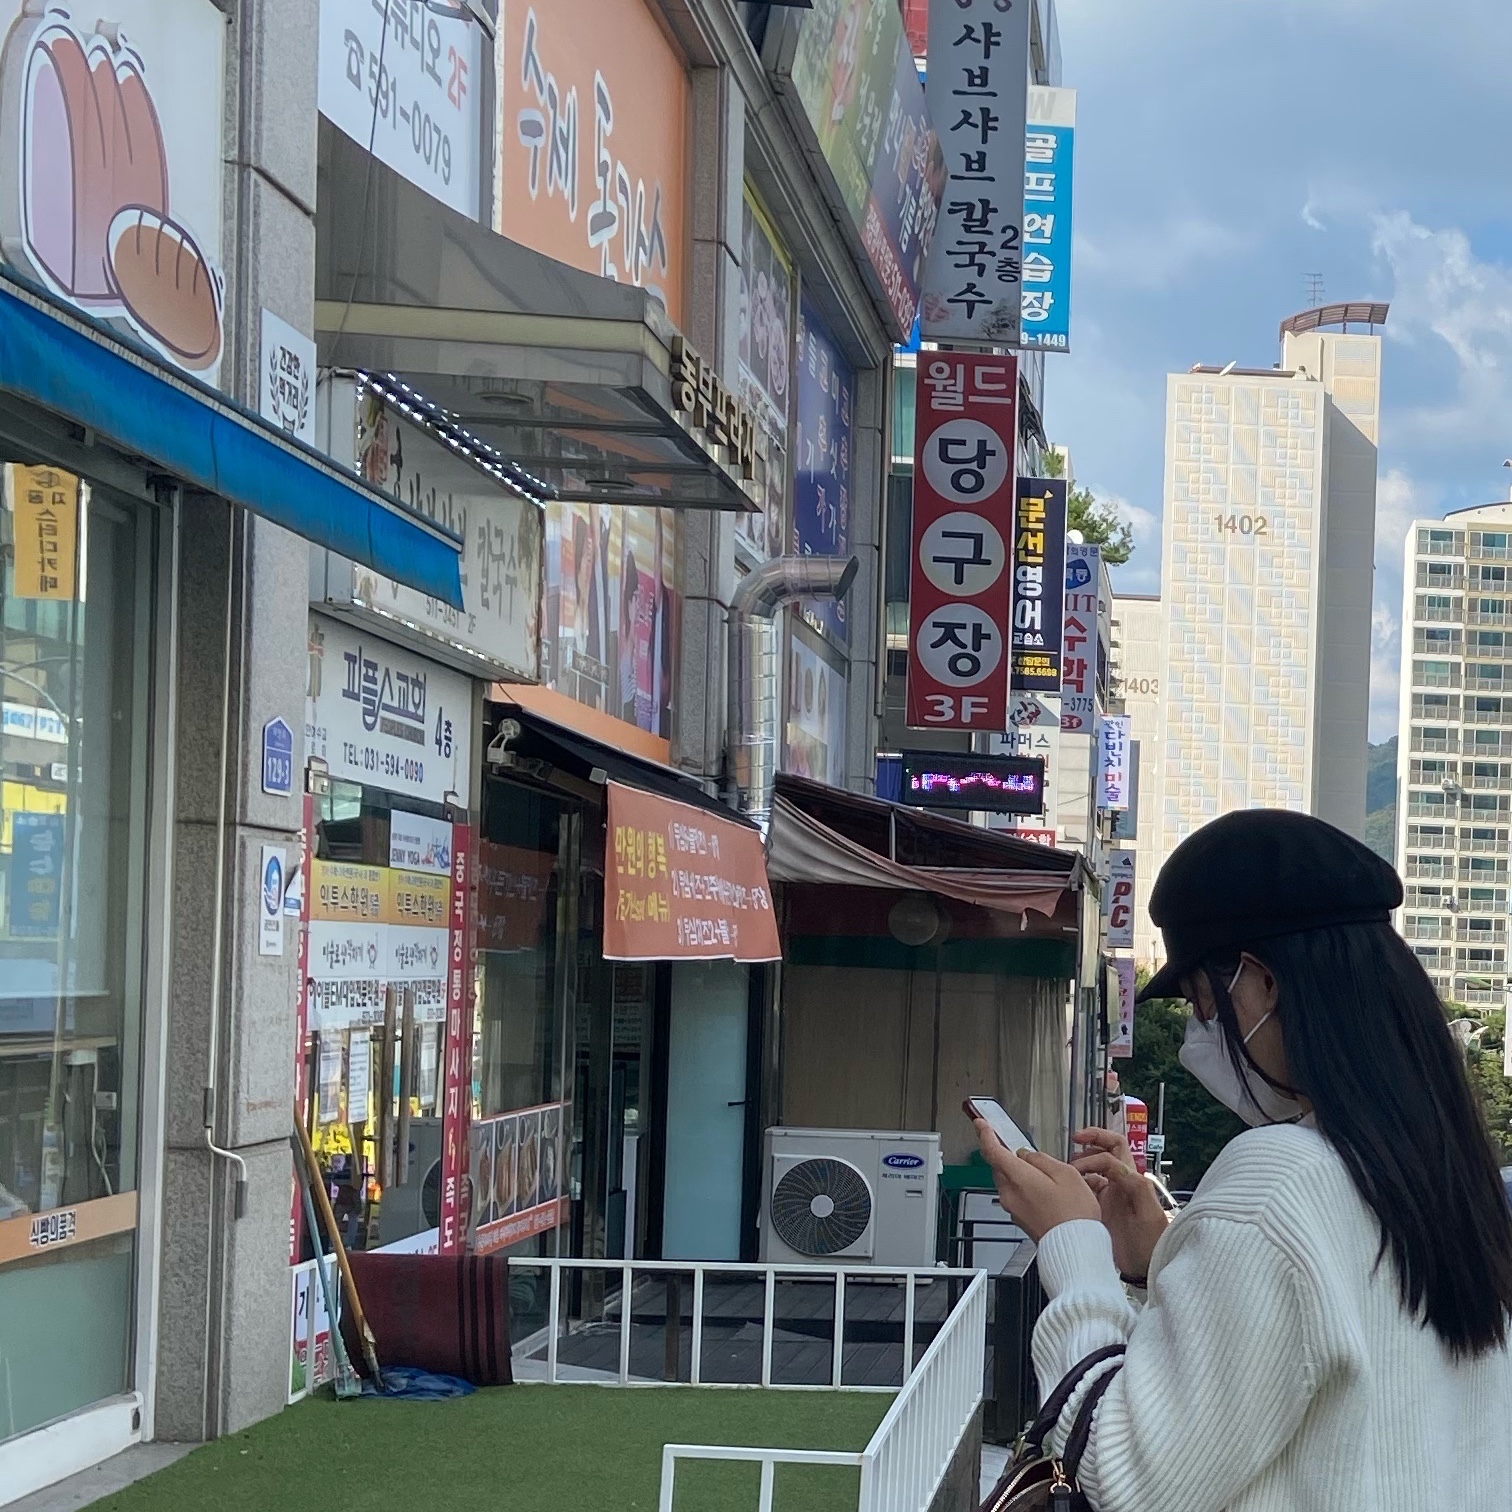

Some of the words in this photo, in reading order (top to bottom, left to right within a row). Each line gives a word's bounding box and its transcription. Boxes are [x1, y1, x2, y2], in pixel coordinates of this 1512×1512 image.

[372, 0, 442, 88] 튜디오
[368, 51, 451, 187] 591-0079
[517, 6, 578, 222] 수제
[946, 21, 1002, 319] 샤브샤브칼국수
[1020, 132, 1057, 322] 골프연습장
[995, 225, 1021, 283] 2층
[924, 361, 1013, 411] 월드
[1213, 514, 1268, 536] 1402
[929, 437, 998, 678] 당구장
[1063, 615, 1088, 693] 수학
[342, 646, 427, 732] 피플스교회
[924, 692, 989, 722] 3F
[1123, 678, 1159, 694] 1403
[434, 706, 453, 758] 4층
[1000, 733, 1052, 750] 파머스
[1103, 731, 1126, 768] 다빈치
[267, 755, 290, 785] 129-3
[1103, 772, 1123, 802] 미술
[614, 825, 645, 878] 만원의
[647, 831, 669, 881] 행복
[1110, 881, 1133, 929] PC
[888, 1156, 920, 1166] Carrier
